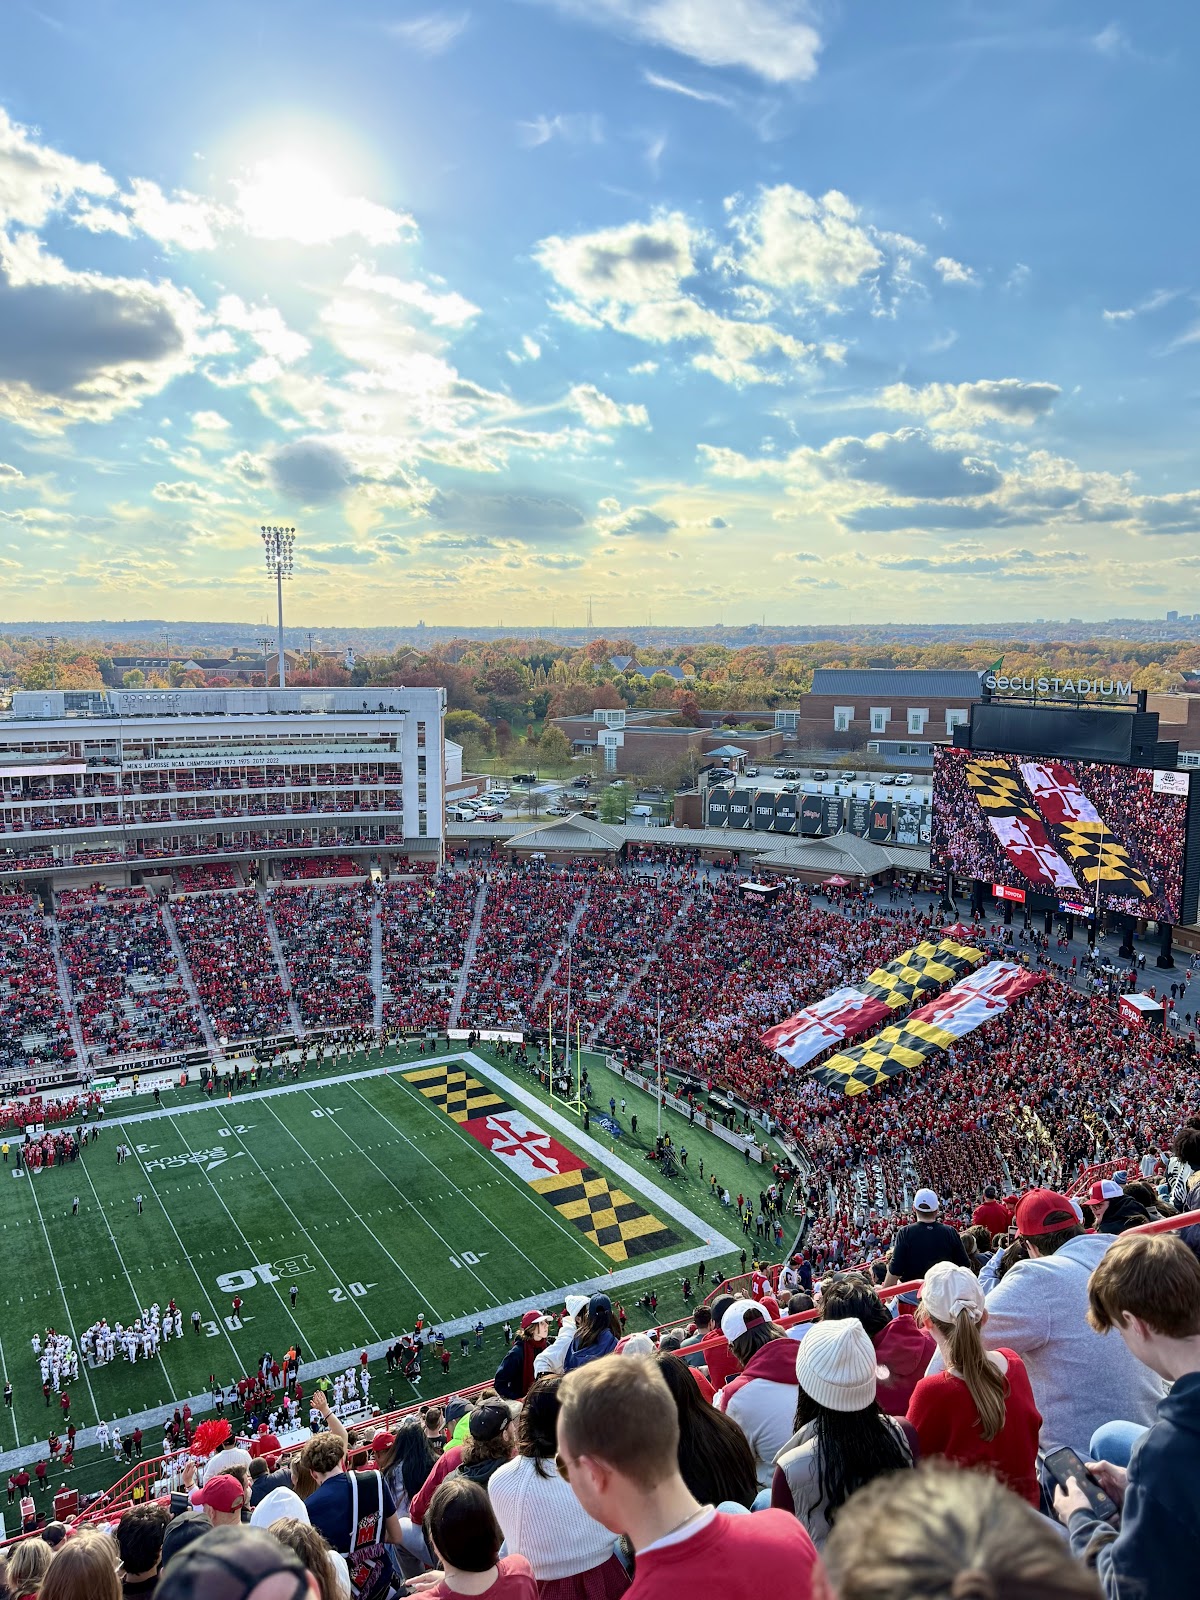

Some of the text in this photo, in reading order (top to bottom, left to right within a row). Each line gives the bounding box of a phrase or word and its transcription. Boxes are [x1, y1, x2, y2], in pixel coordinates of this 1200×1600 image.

[1037, 677, 1132, 696] STADIUM
[756, 806, 774, 816] FIGHT
[1004, 889, 1023, 899] TOYOTA
[1121, 1005, 1140, 1023] Terps
[449, 1250, 481, 1269] 10
[328, 1281, 368, 1303] 20
[201, 1315, 244, 1338] 30
